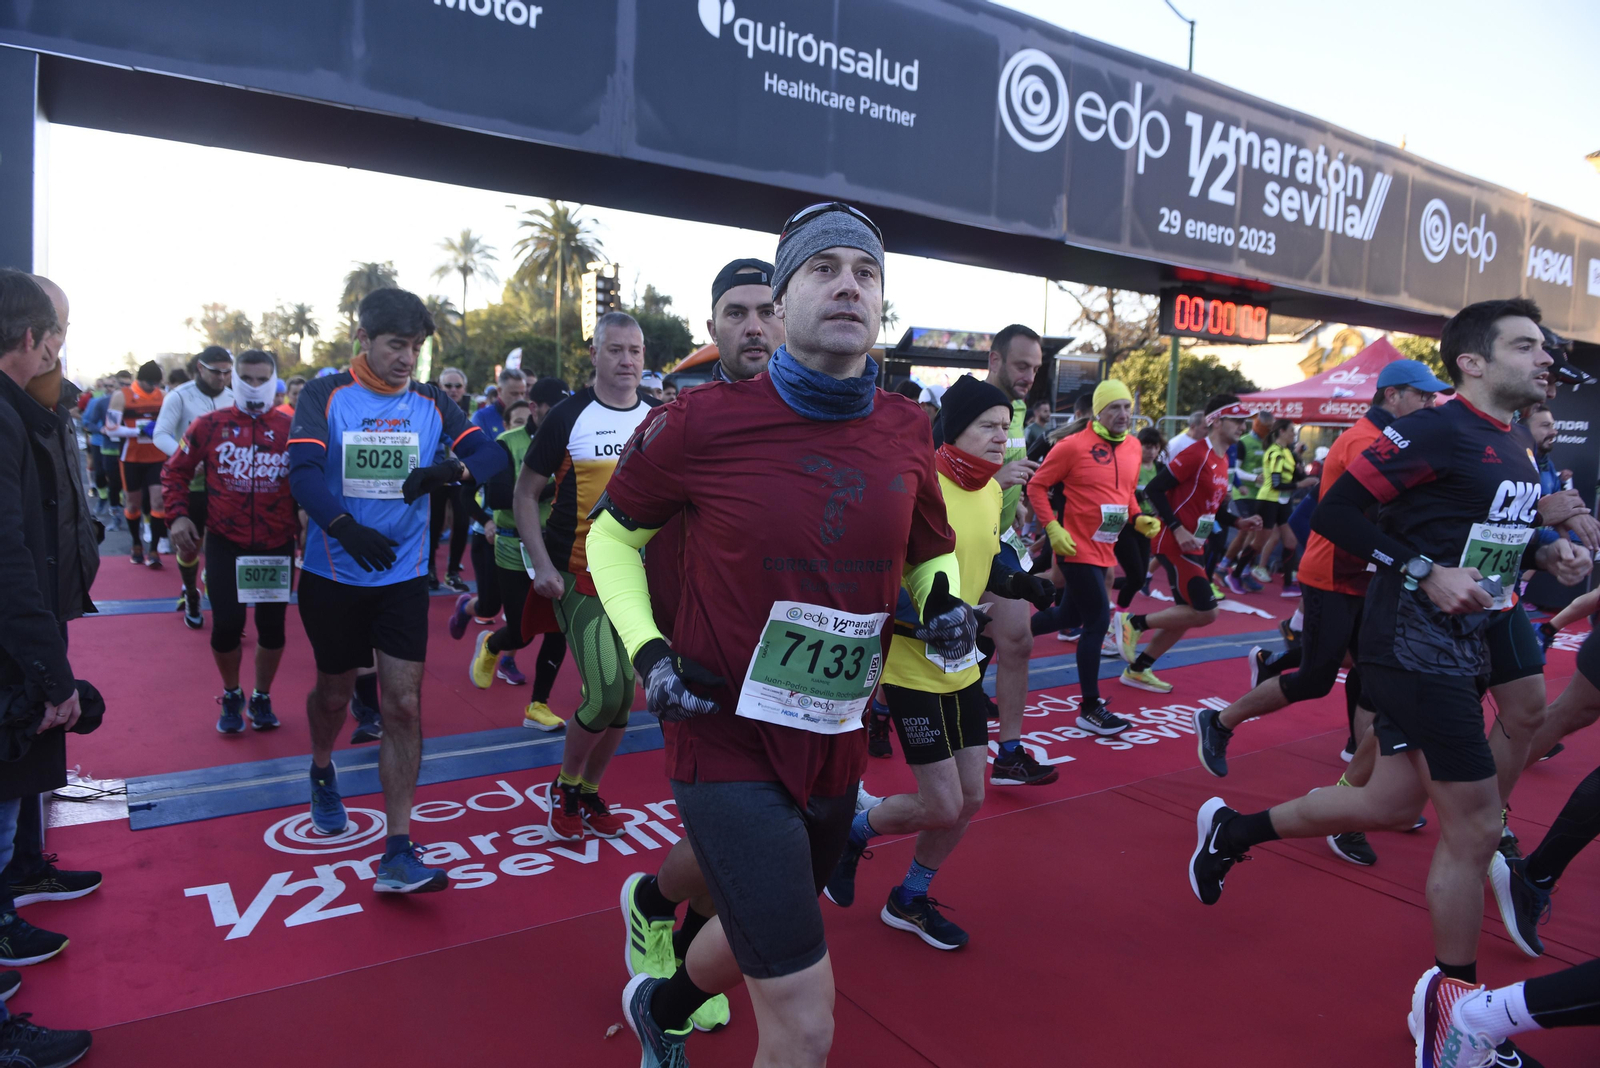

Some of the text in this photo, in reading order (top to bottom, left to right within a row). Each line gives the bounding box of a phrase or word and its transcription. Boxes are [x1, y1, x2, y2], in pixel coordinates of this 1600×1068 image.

[733, 15, 919, 92] quirónsalud
[763, 70, 918, 128] Healthcare Partner
[1074, 81, 1171, 175] edp
[1229, 124, 1365, 201] maratón
[1158, 206, 1276, 256] 29 enero 2023
[1452, 213, 1497, 274] edp
[1526, 244, 1574, 288] HOKA
[356, 448, 404, 469] 5028
[595, 443, 626, 457] LOG
[245, 567, 277, 582] 5072
[763, 557, 893, 573] CORRER CORRER
[800, 577, 859, 594] Runners
[803, 611, 829, 627] edp
[779, 630, 865, 681] 7133
[810, 687, 834, 698] Sevilla
[781, 709, 799, 718] HOKA
[813, 700, 834, 712] edp
[902, 717, 930, 726] RODI
[909, 736, 936, 745] LLEIDA
[317, 798, 678, 881] maraón
[446, 819, 684, 890] sevill
